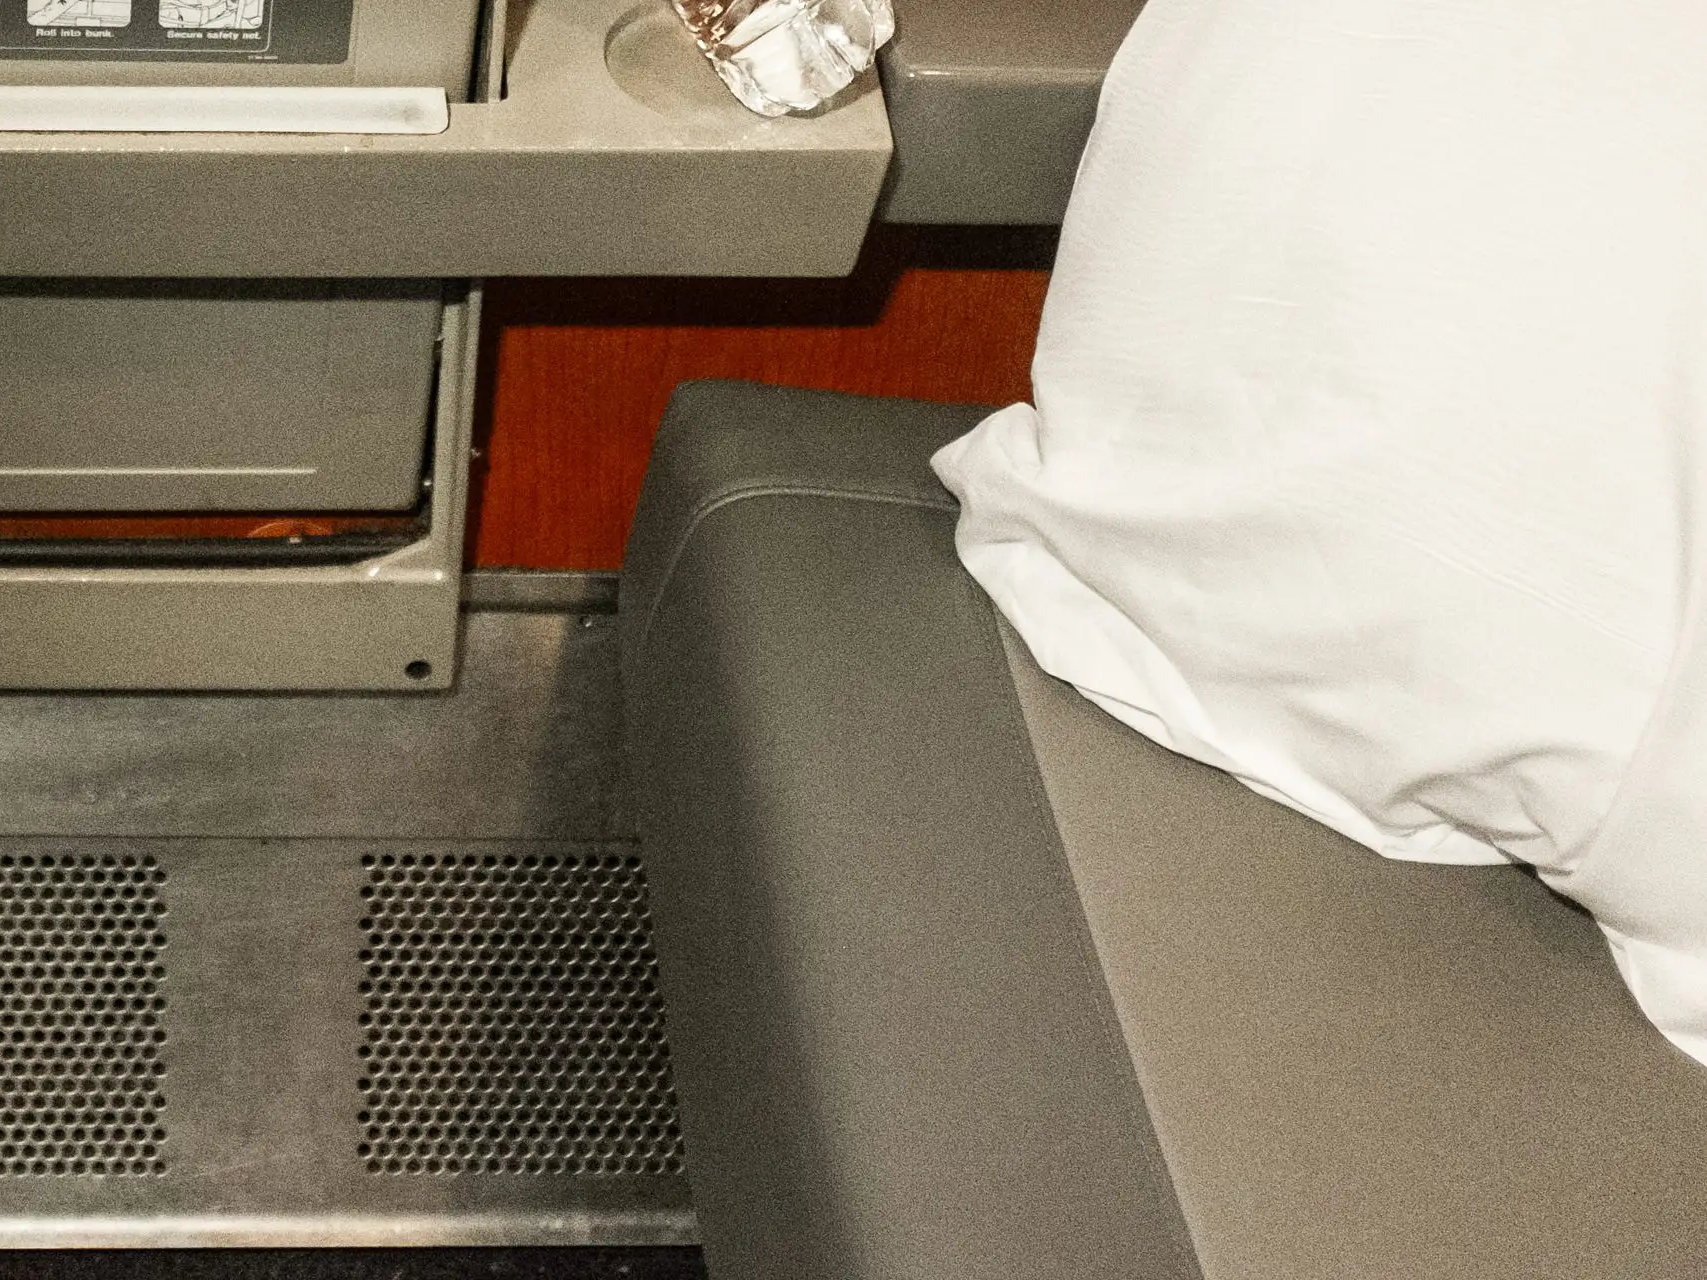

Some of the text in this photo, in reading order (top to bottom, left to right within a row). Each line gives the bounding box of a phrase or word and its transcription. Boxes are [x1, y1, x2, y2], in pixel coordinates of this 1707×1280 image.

[166, 30, 260, 40] Secure safety net.
